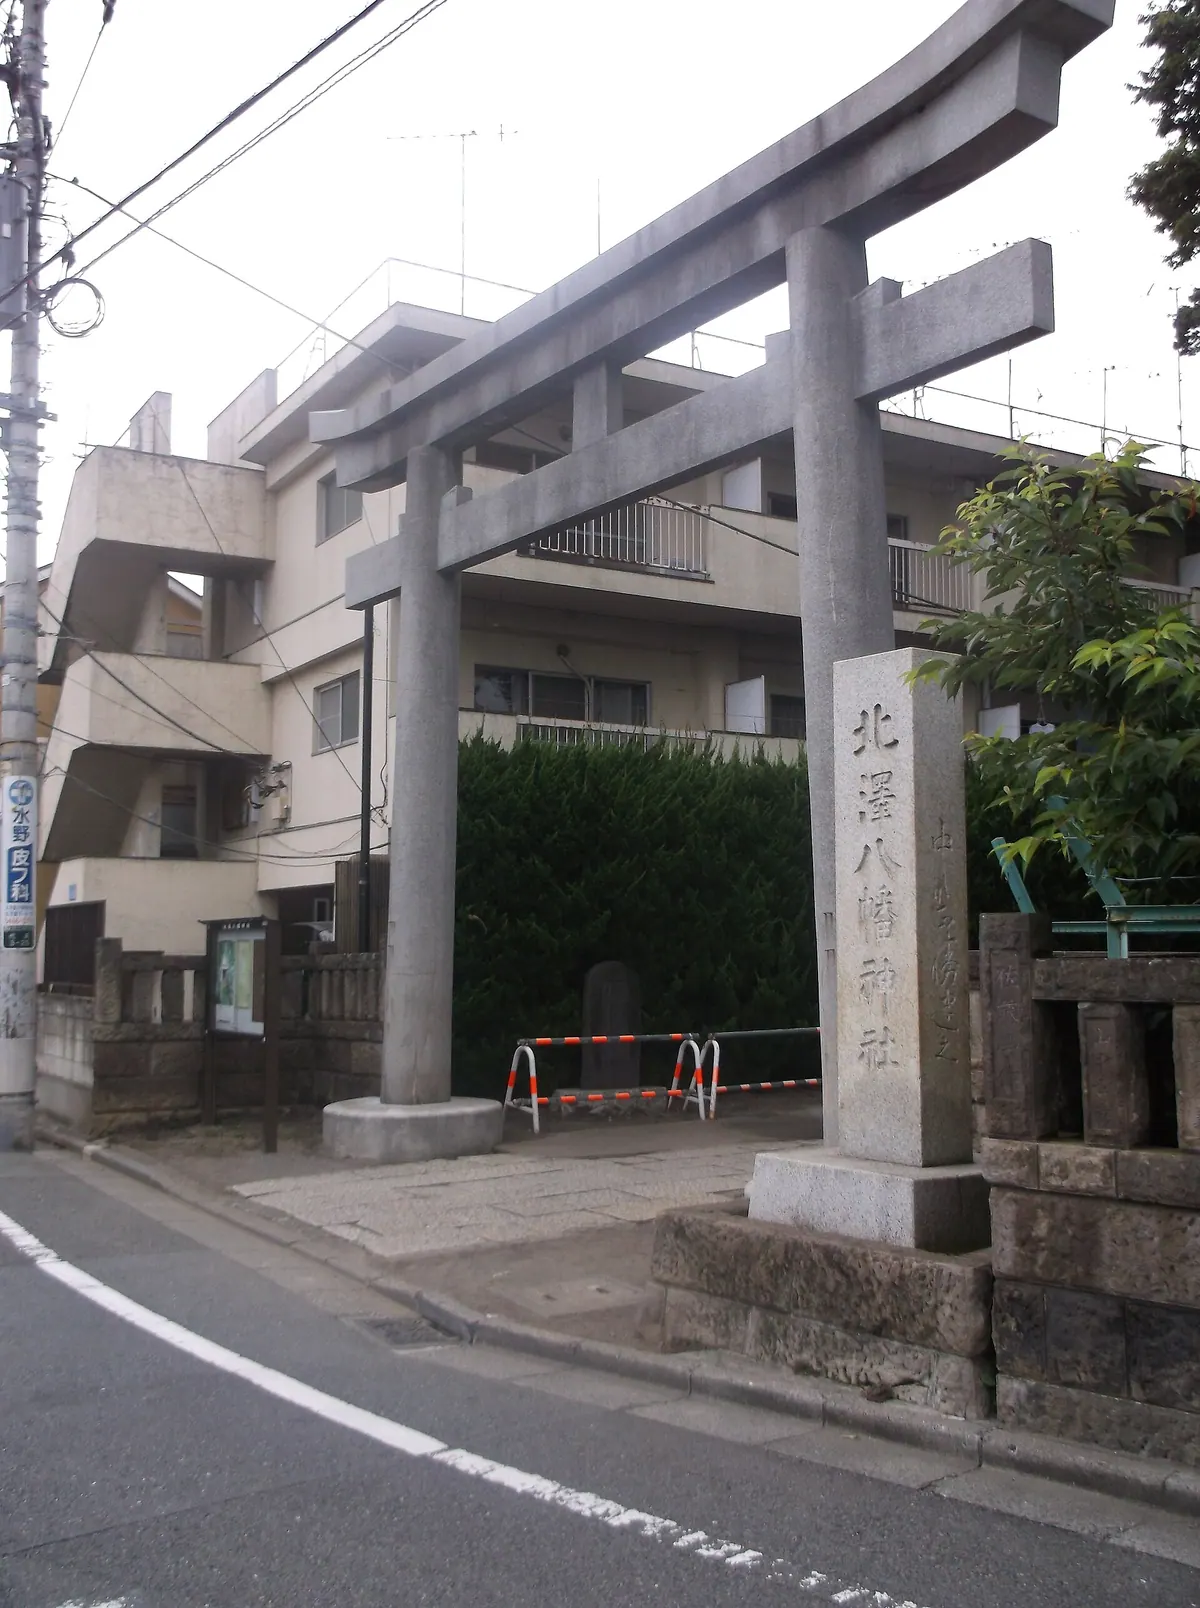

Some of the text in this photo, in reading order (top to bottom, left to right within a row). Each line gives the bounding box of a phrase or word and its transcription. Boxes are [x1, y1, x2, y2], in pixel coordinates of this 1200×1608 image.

[853, 703, 900, 1070] 北澤八幡神社
